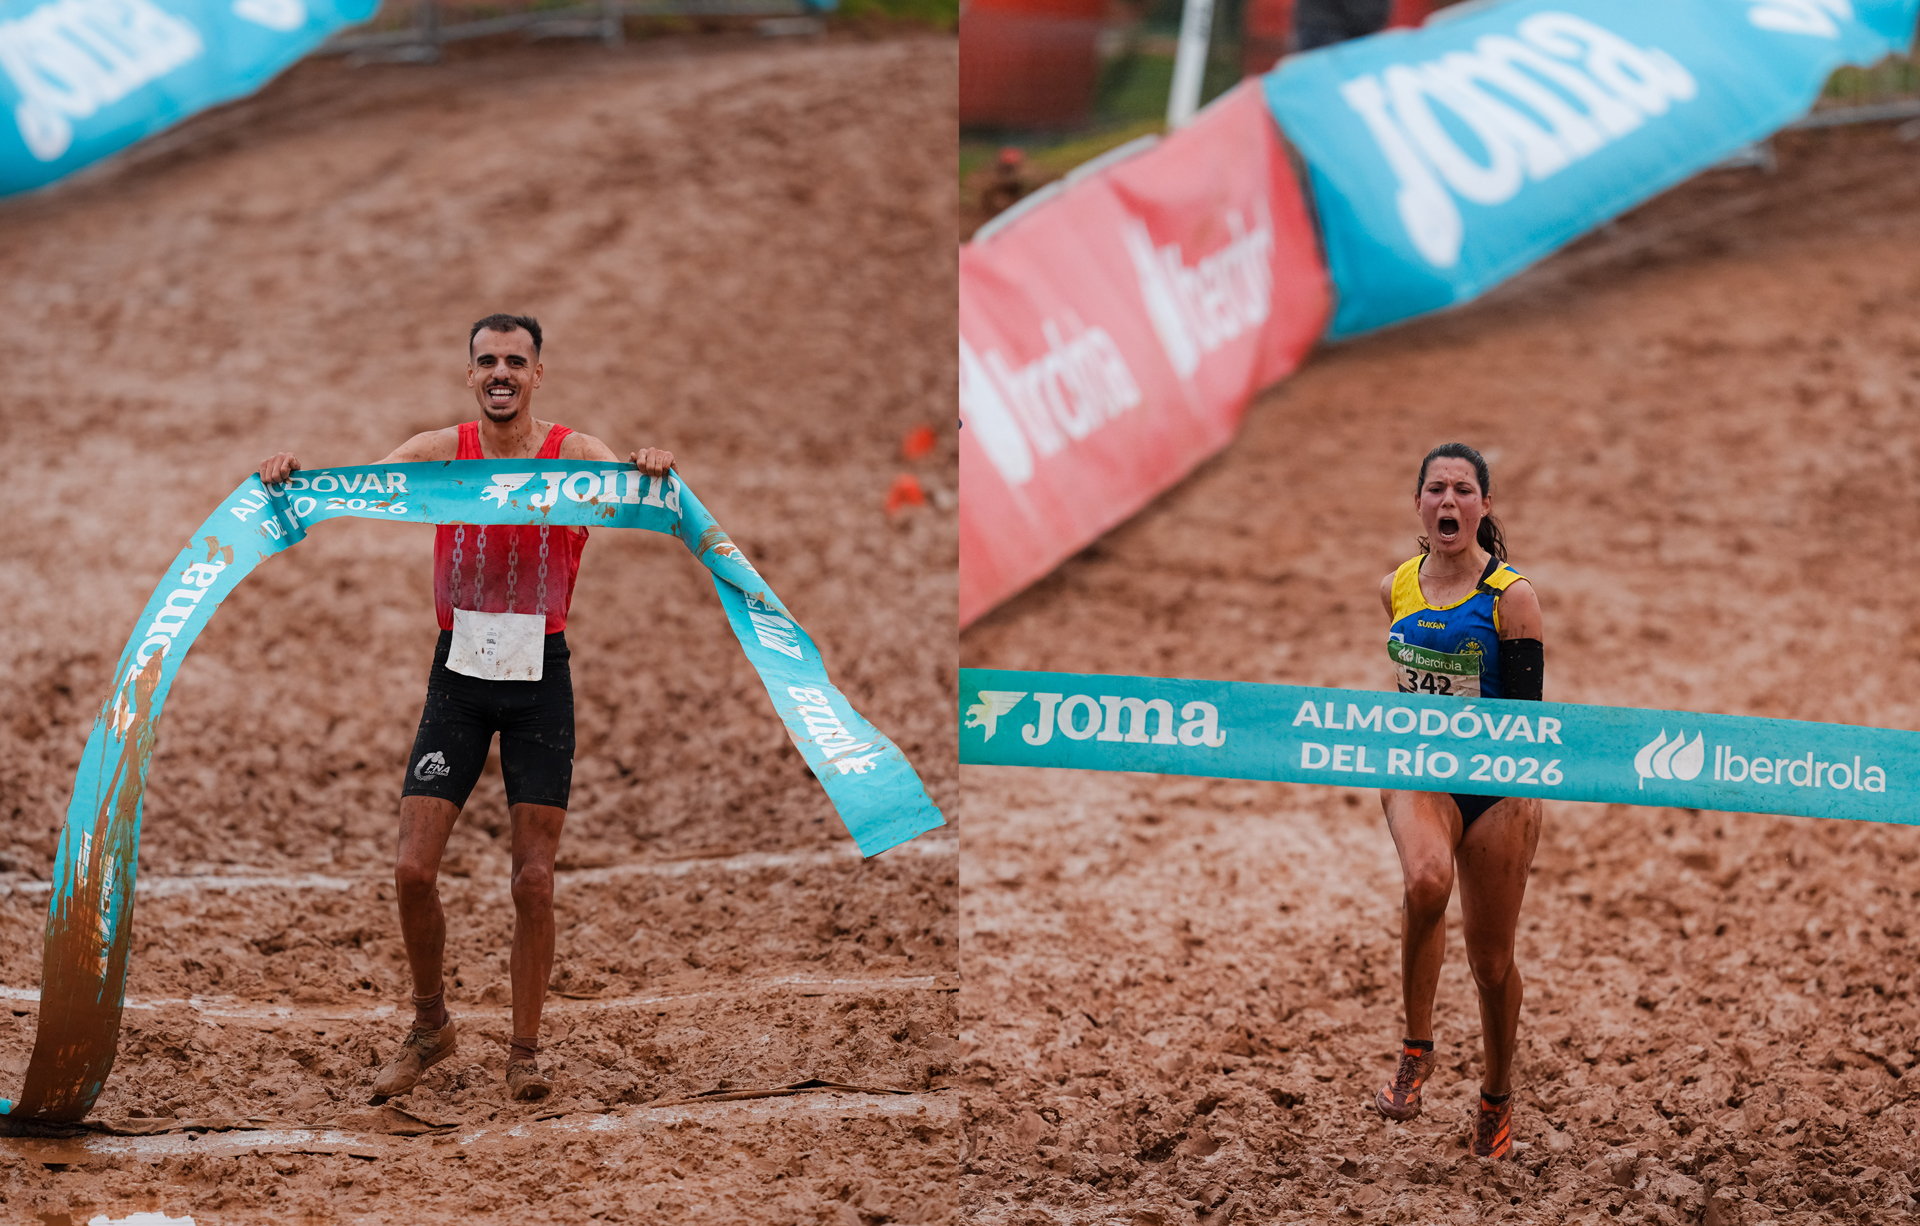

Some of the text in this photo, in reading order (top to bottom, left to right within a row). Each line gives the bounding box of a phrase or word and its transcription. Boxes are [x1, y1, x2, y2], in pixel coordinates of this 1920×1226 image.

[1341, 12, 1697, 268] Joma
[325, 497, 408, 515] 2026
[530, 470, 683, 520] Joma
[1417, 619, 1446, 630] SUKAN
[1405, 669, 1454, 697] 342
[1415, 652, 1462, 672] Iberdrola
[1021, 692, 1227, 748] Joma
[1292, 700, 1563, 745] ALMODÓVAR
[426, 763, 451, 774] FNA
[1300, 742, 1564, 786] DEL RÍO 2026
[1714, 745, 1886, 793] Iberdrola
